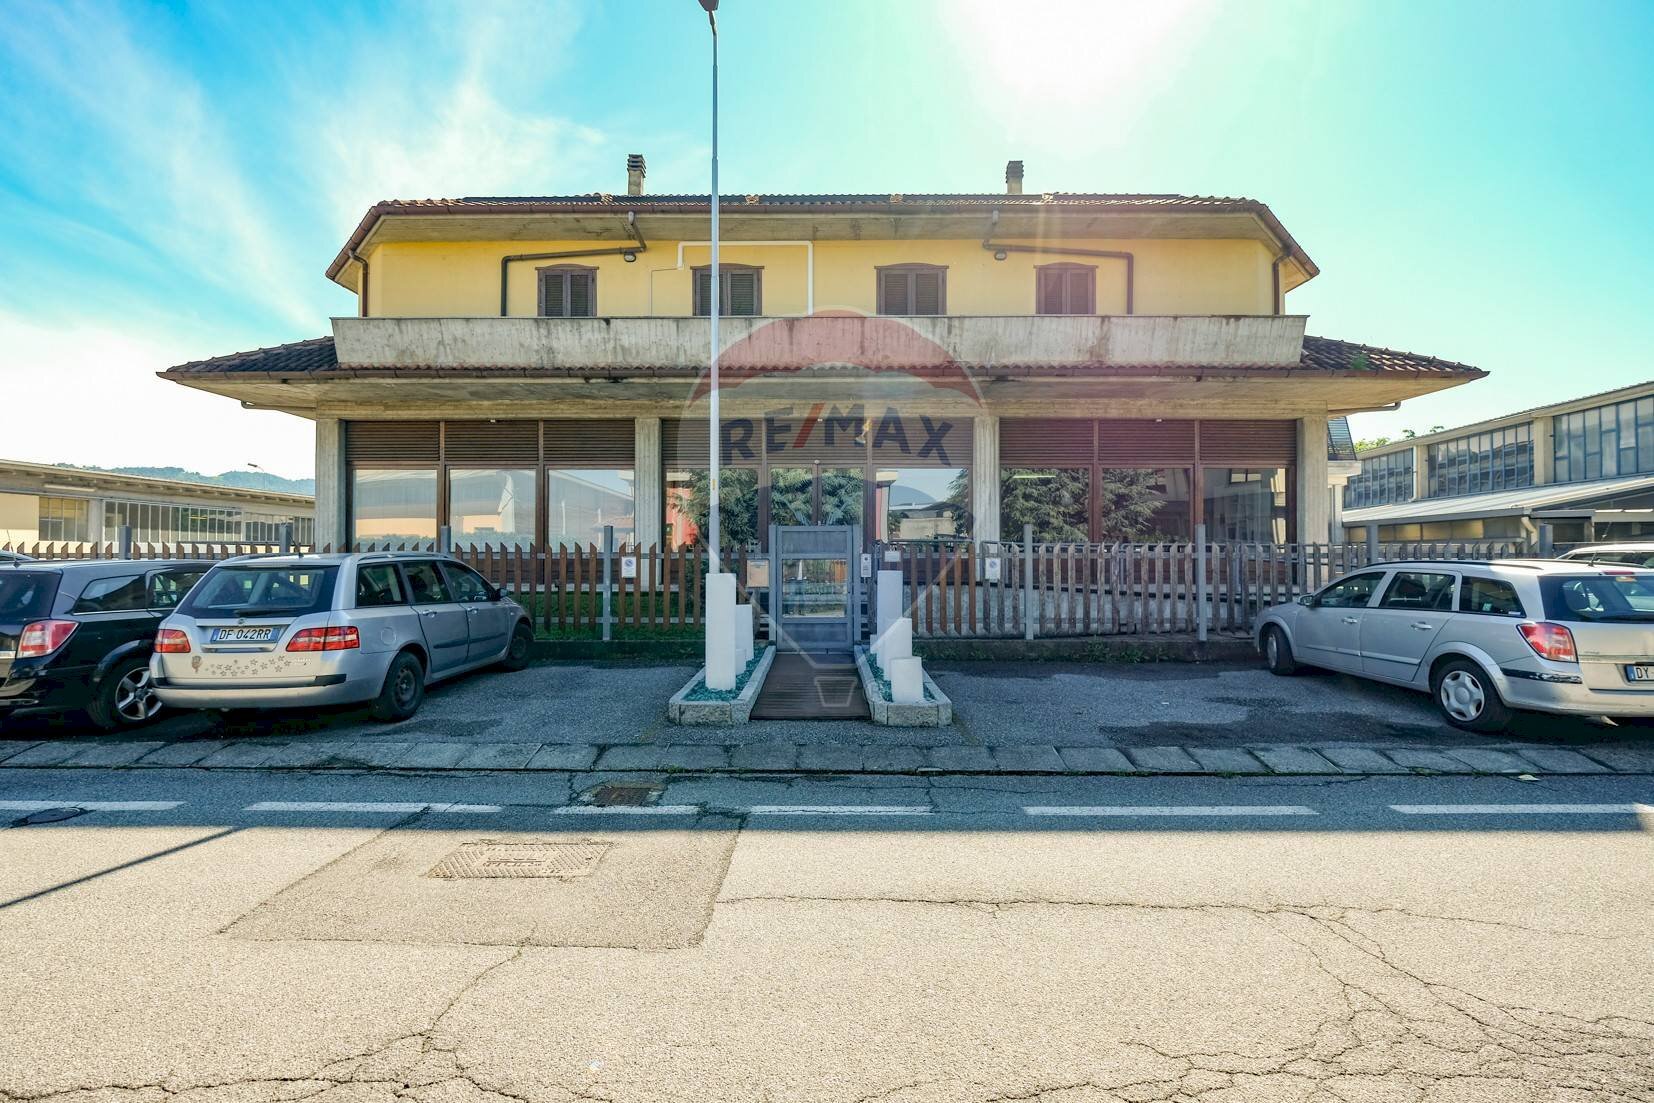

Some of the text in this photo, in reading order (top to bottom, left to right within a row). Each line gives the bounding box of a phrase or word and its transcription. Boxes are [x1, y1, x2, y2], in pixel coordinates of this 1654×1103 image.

[218, 628, 272, 640] DF 042RR
[1636, 667, 1649, 679] DY
